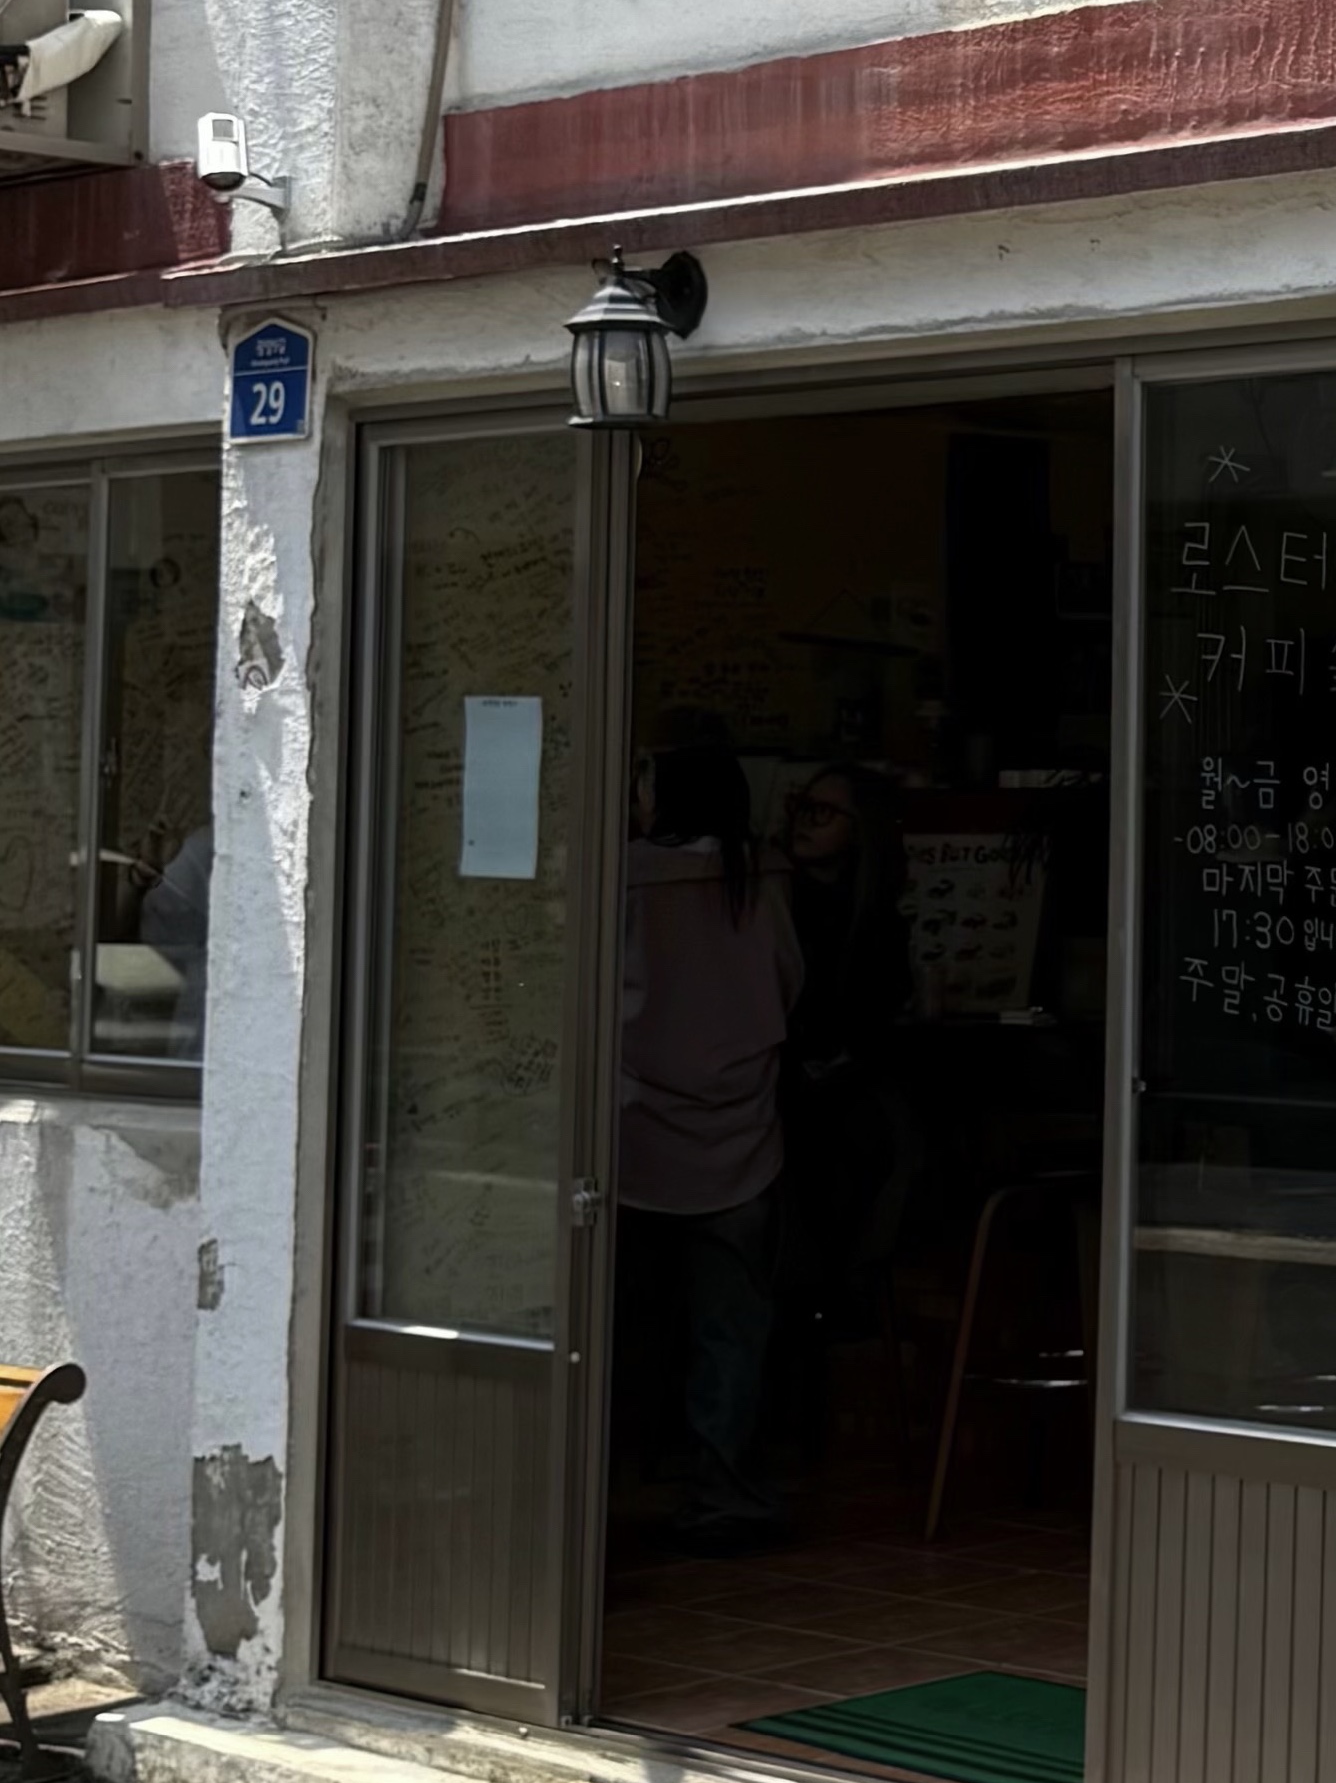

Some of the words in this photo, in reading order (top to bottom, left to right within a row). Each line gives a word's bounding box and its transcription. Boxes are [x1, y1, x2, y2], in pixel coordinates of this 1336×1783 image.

[249, 381, 286, 426] 29
[1200, 756, 1281, 810] 월~금
[1202, 859, 1295, 906] 마지막
[1212, 908, 1296, 950] 17:30
